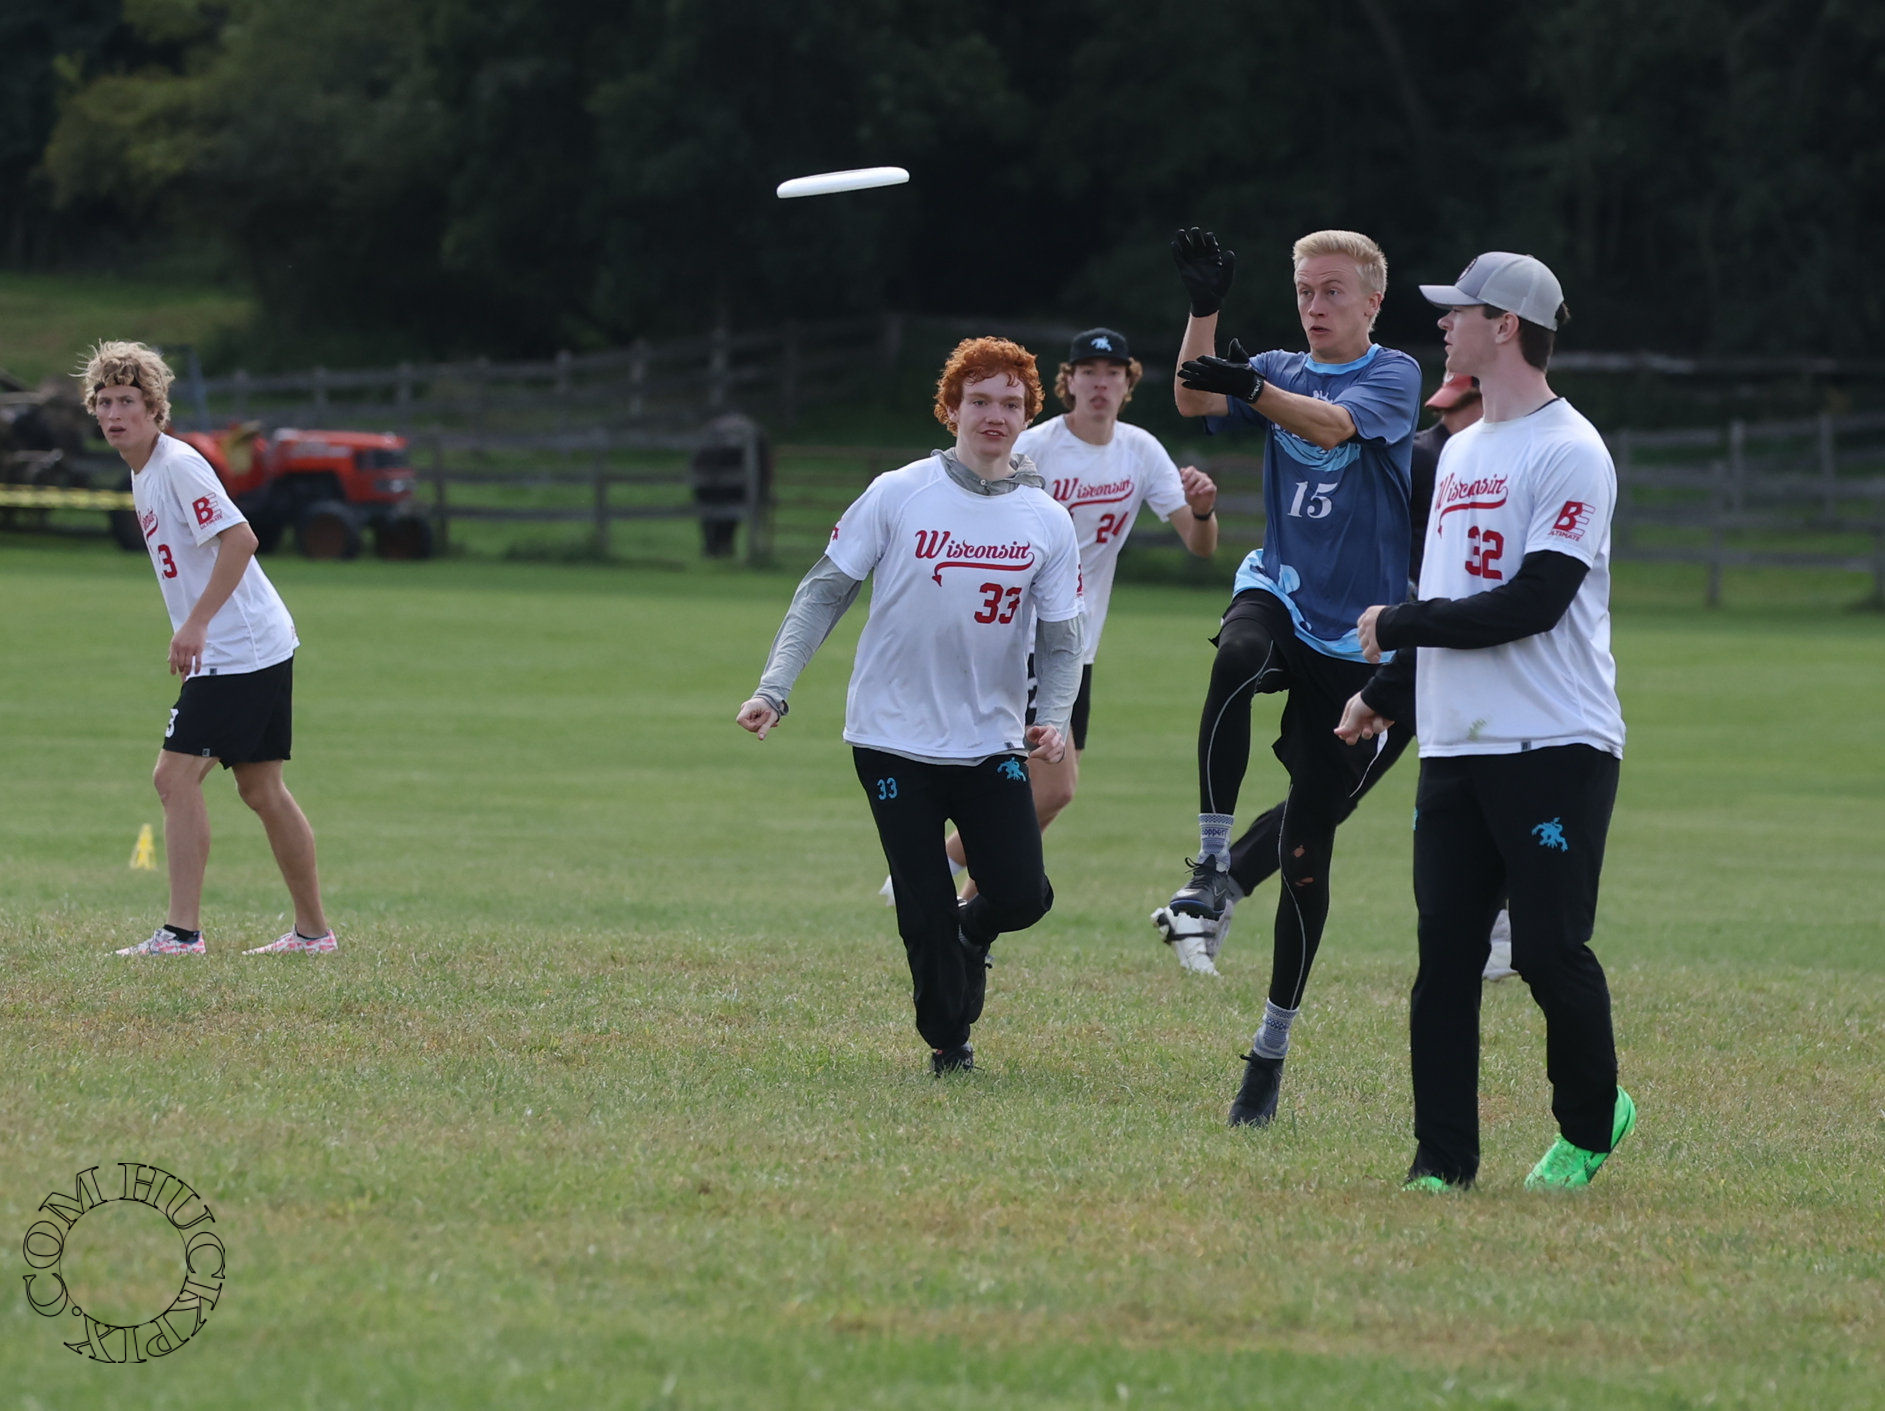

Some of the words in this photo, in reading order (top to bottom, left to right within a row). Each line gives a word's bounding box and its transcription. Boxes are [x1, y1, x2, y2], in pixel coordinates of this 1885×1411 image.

[1052, 475, 1132, 501] Wisconsin
[1287, 481, 1338, 519] 15
[914, 529, 1033, 559] Wisconsin
[1465, 525, 1504, 581] 32
[974, 582, 1023, 624] 33
[877, 777, 898, 800] 33
